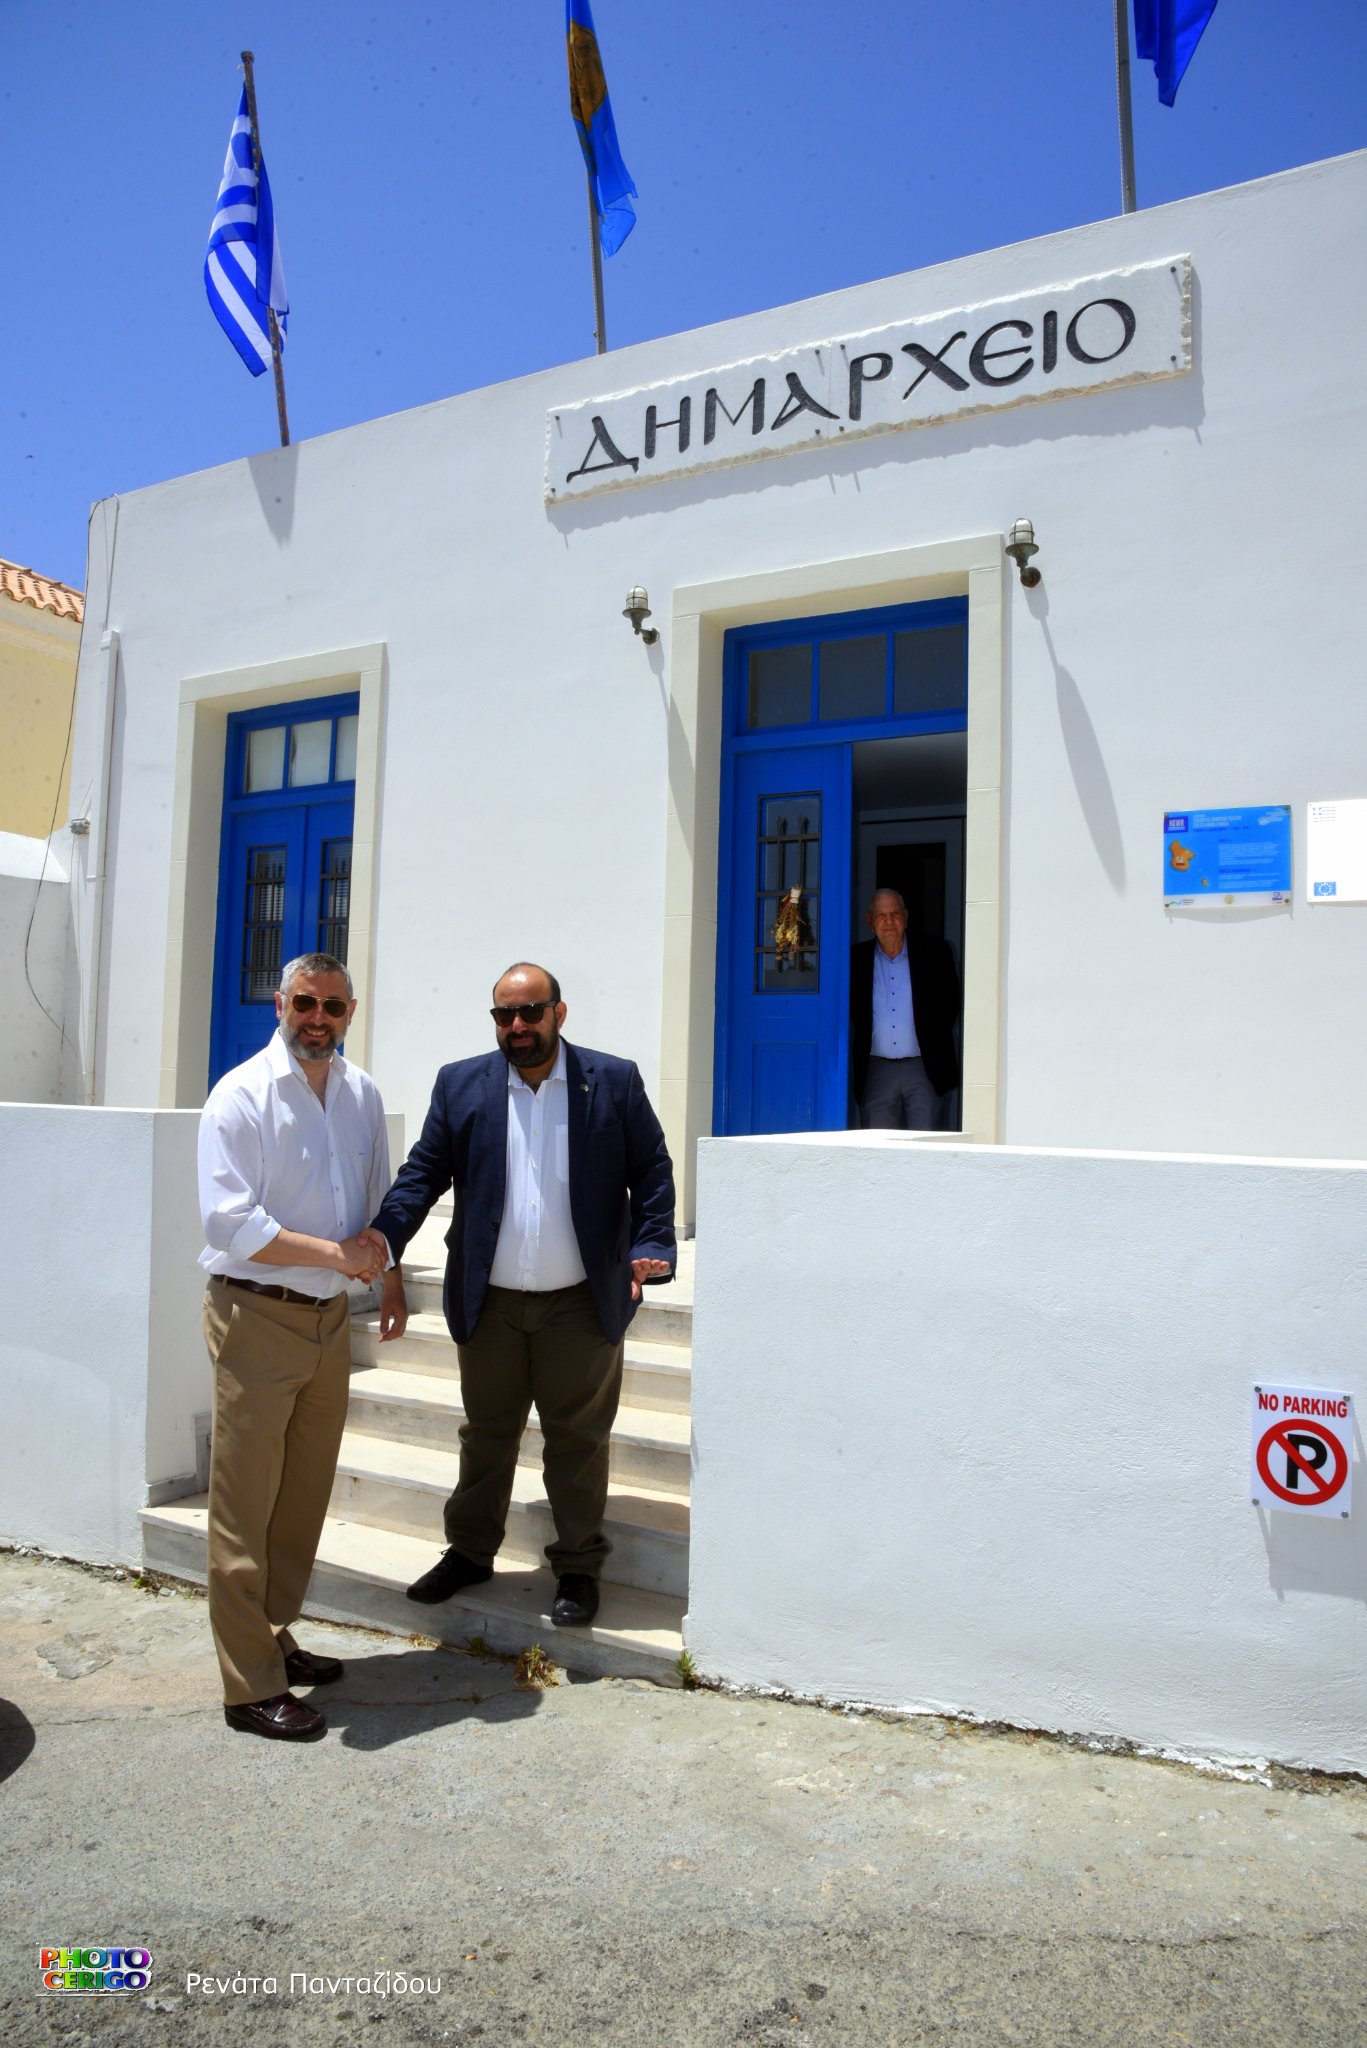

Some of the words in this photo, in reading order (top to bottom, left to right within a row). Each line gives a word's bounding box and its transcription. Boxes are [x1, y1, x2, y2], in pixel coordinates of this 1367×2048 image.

[566, 298, 1137, 483] ΔΗΜΑΡΧΕΙΟ
[1258, 1393, 1279, 1412] NO
[1283, 1395, 1348, 1418] PARKING
[1286, 1433, 1328, 1489] P
